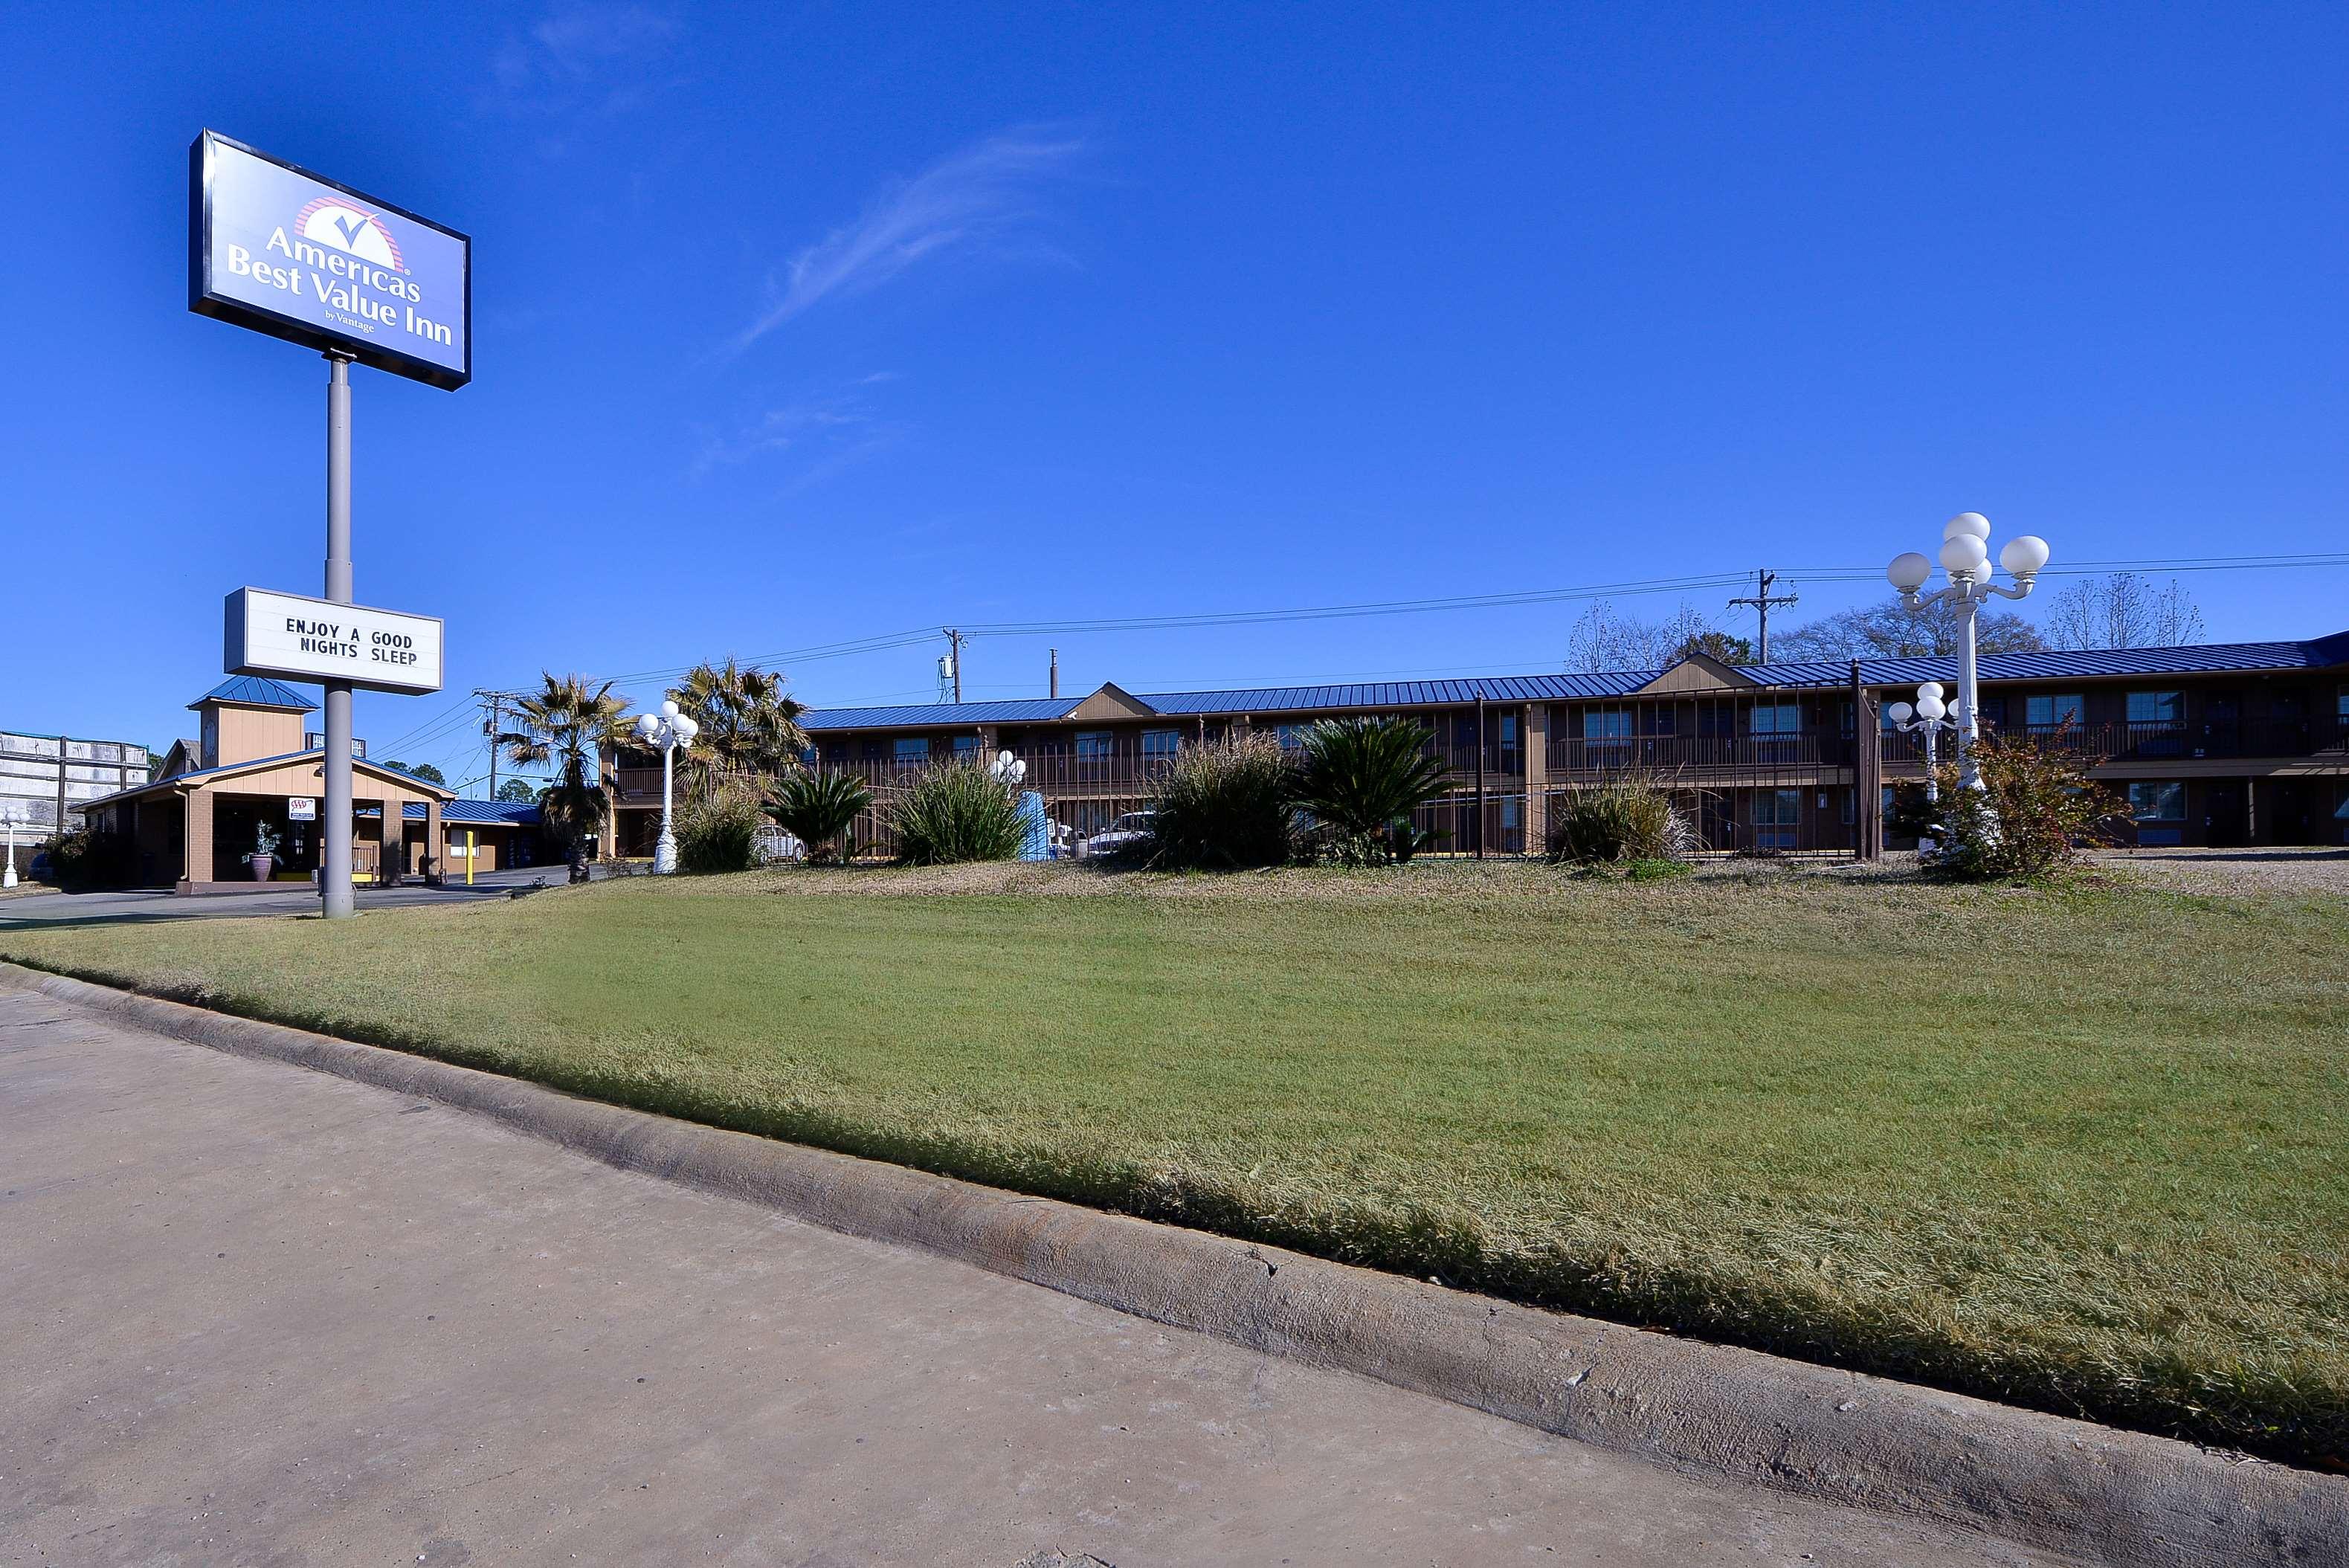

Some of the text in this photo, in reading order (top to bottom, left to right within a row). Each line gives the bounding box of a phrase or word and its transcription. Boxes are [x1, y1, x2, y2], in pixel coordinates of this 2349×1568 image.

[265, 225, 421, 303] Americas
[227, 243, 452, 346] Best Value Inn
[325, 309, 375, 334] by Vantage
[286, 618, 413, 649] ENJOY A GOOD
[300, 637, 417, 665] NIGHTS SLEEP
